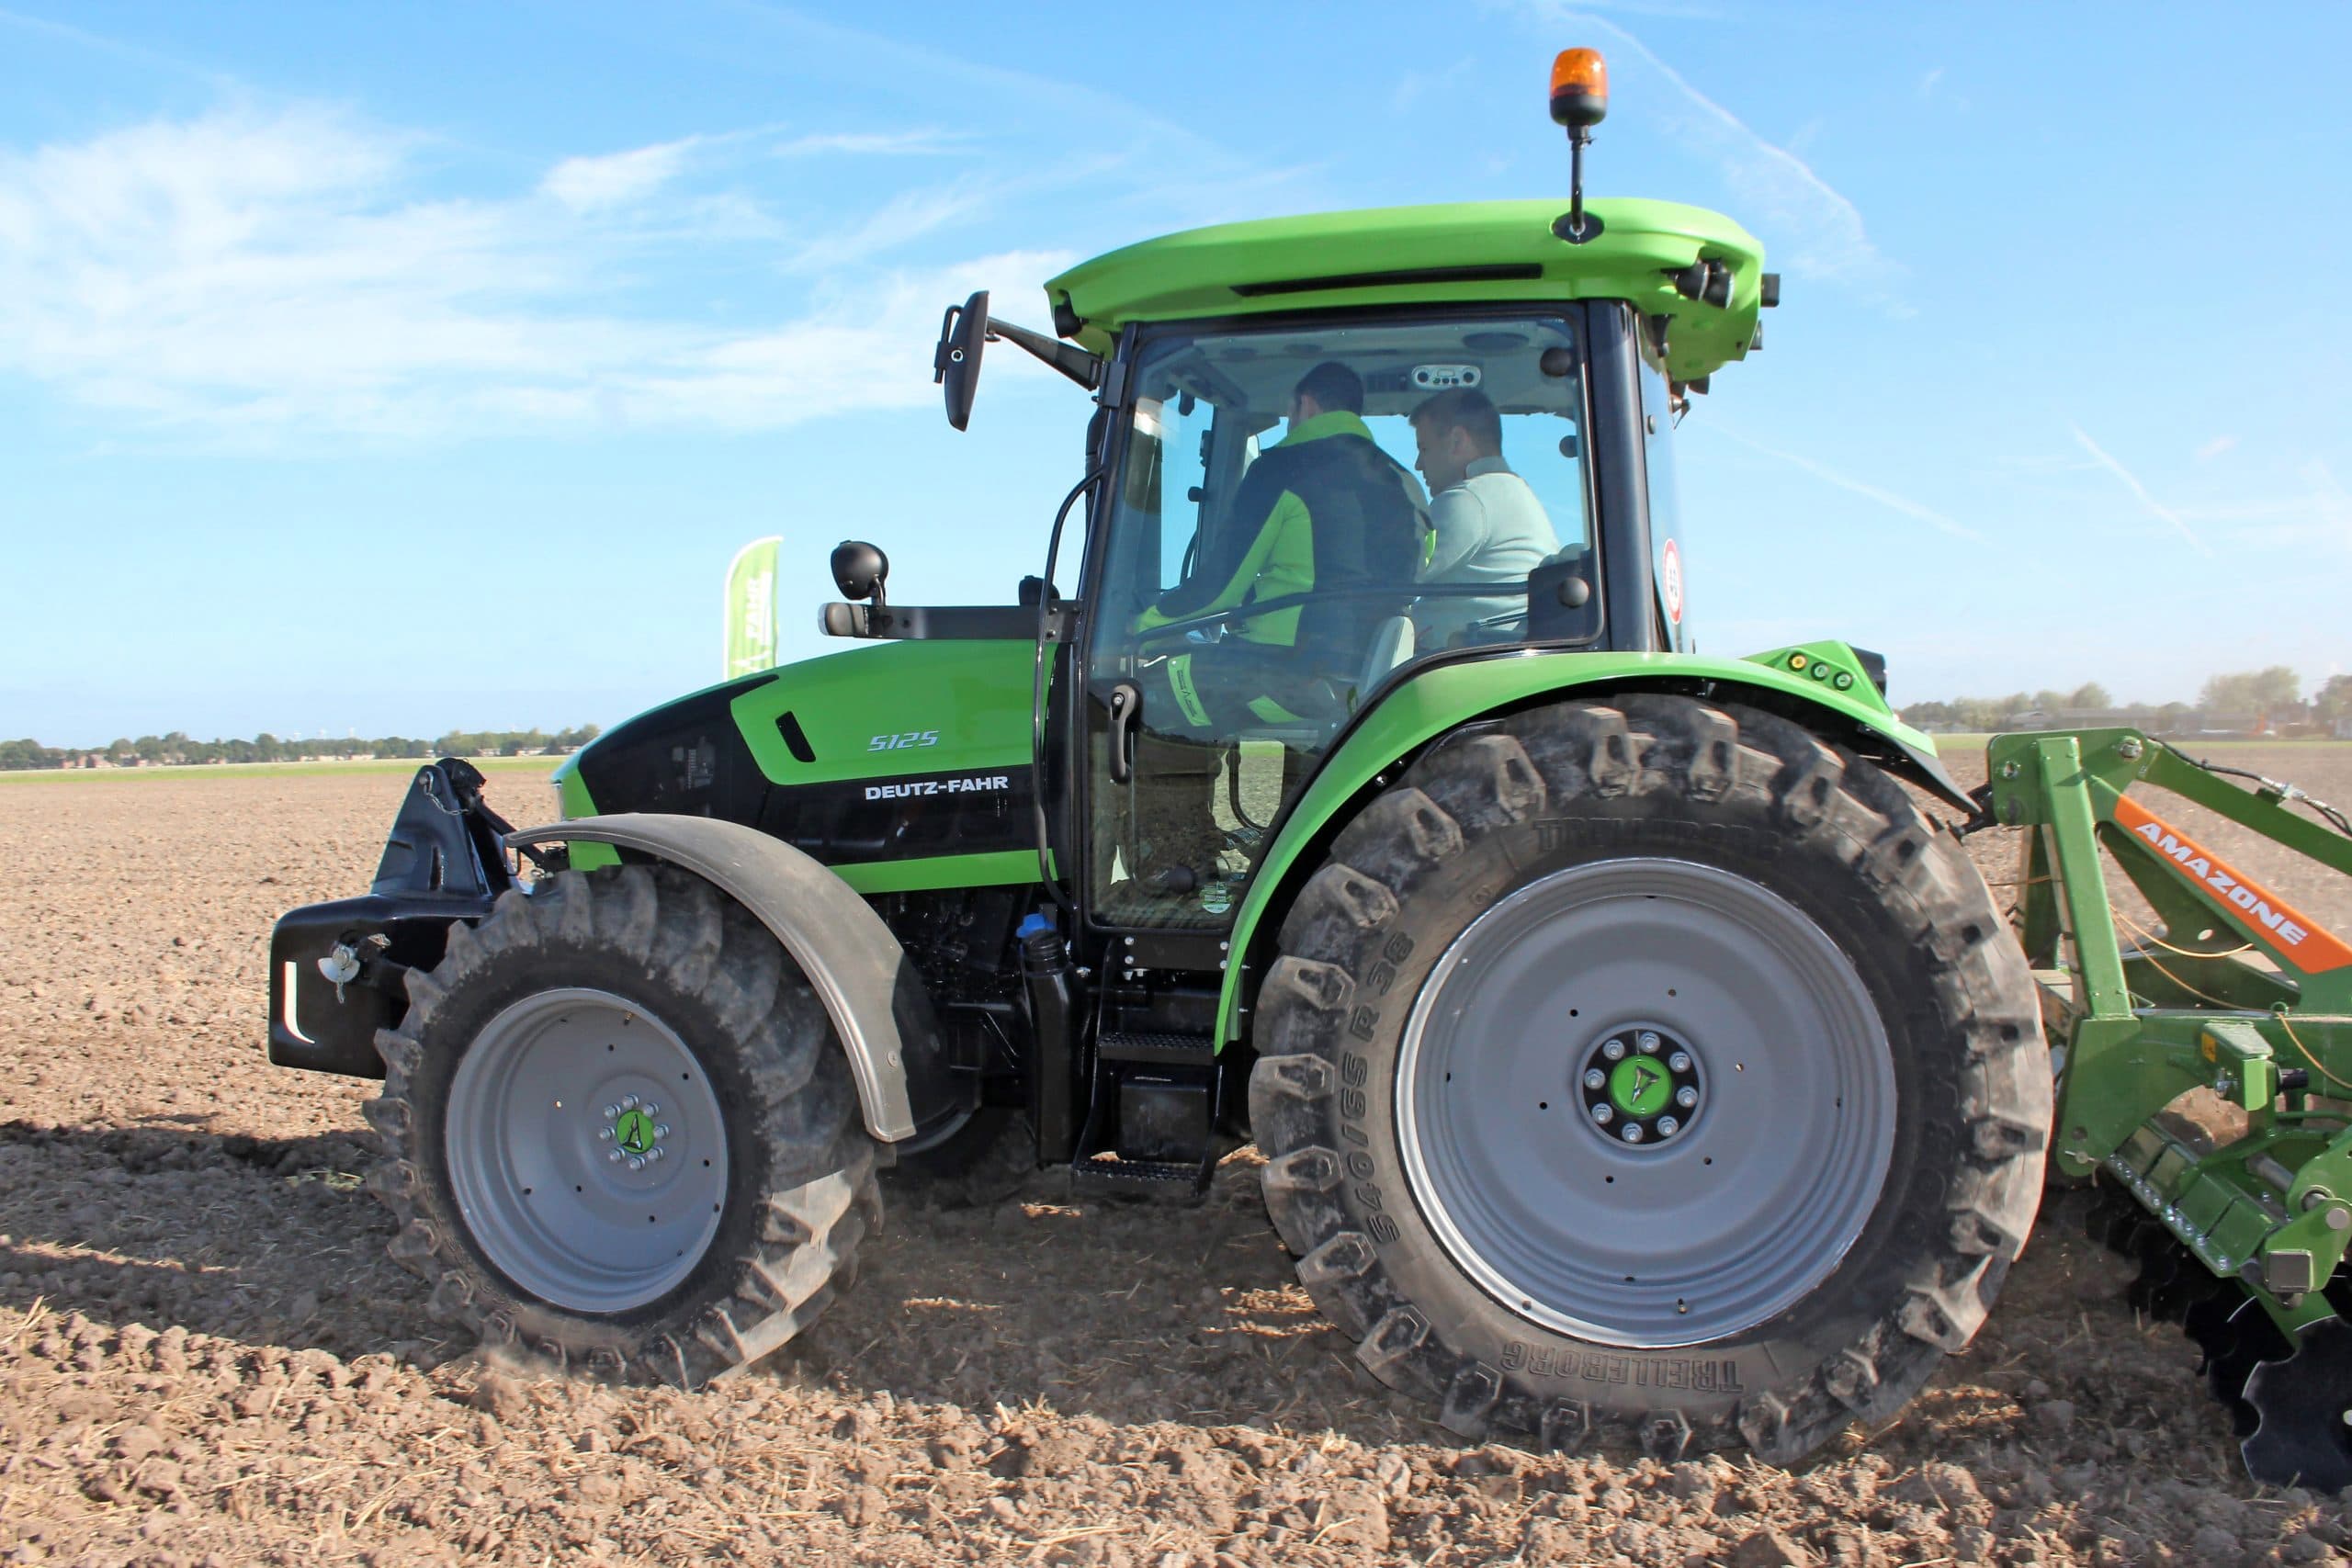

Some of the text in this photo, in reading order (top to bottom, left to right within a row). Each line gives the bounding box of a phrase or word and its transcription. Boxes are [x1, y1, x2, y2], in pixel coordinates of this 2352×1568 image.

[867, 730, 941, 752] 5125
[865, 775, 1009, 800] DEUTZ-FAHR
[2134, 821, 2308, 946] AMAZONE
[1348, 1005, 1380, 1042] R
[1499, 1341, 1744, 1394] TRELLEBORG
